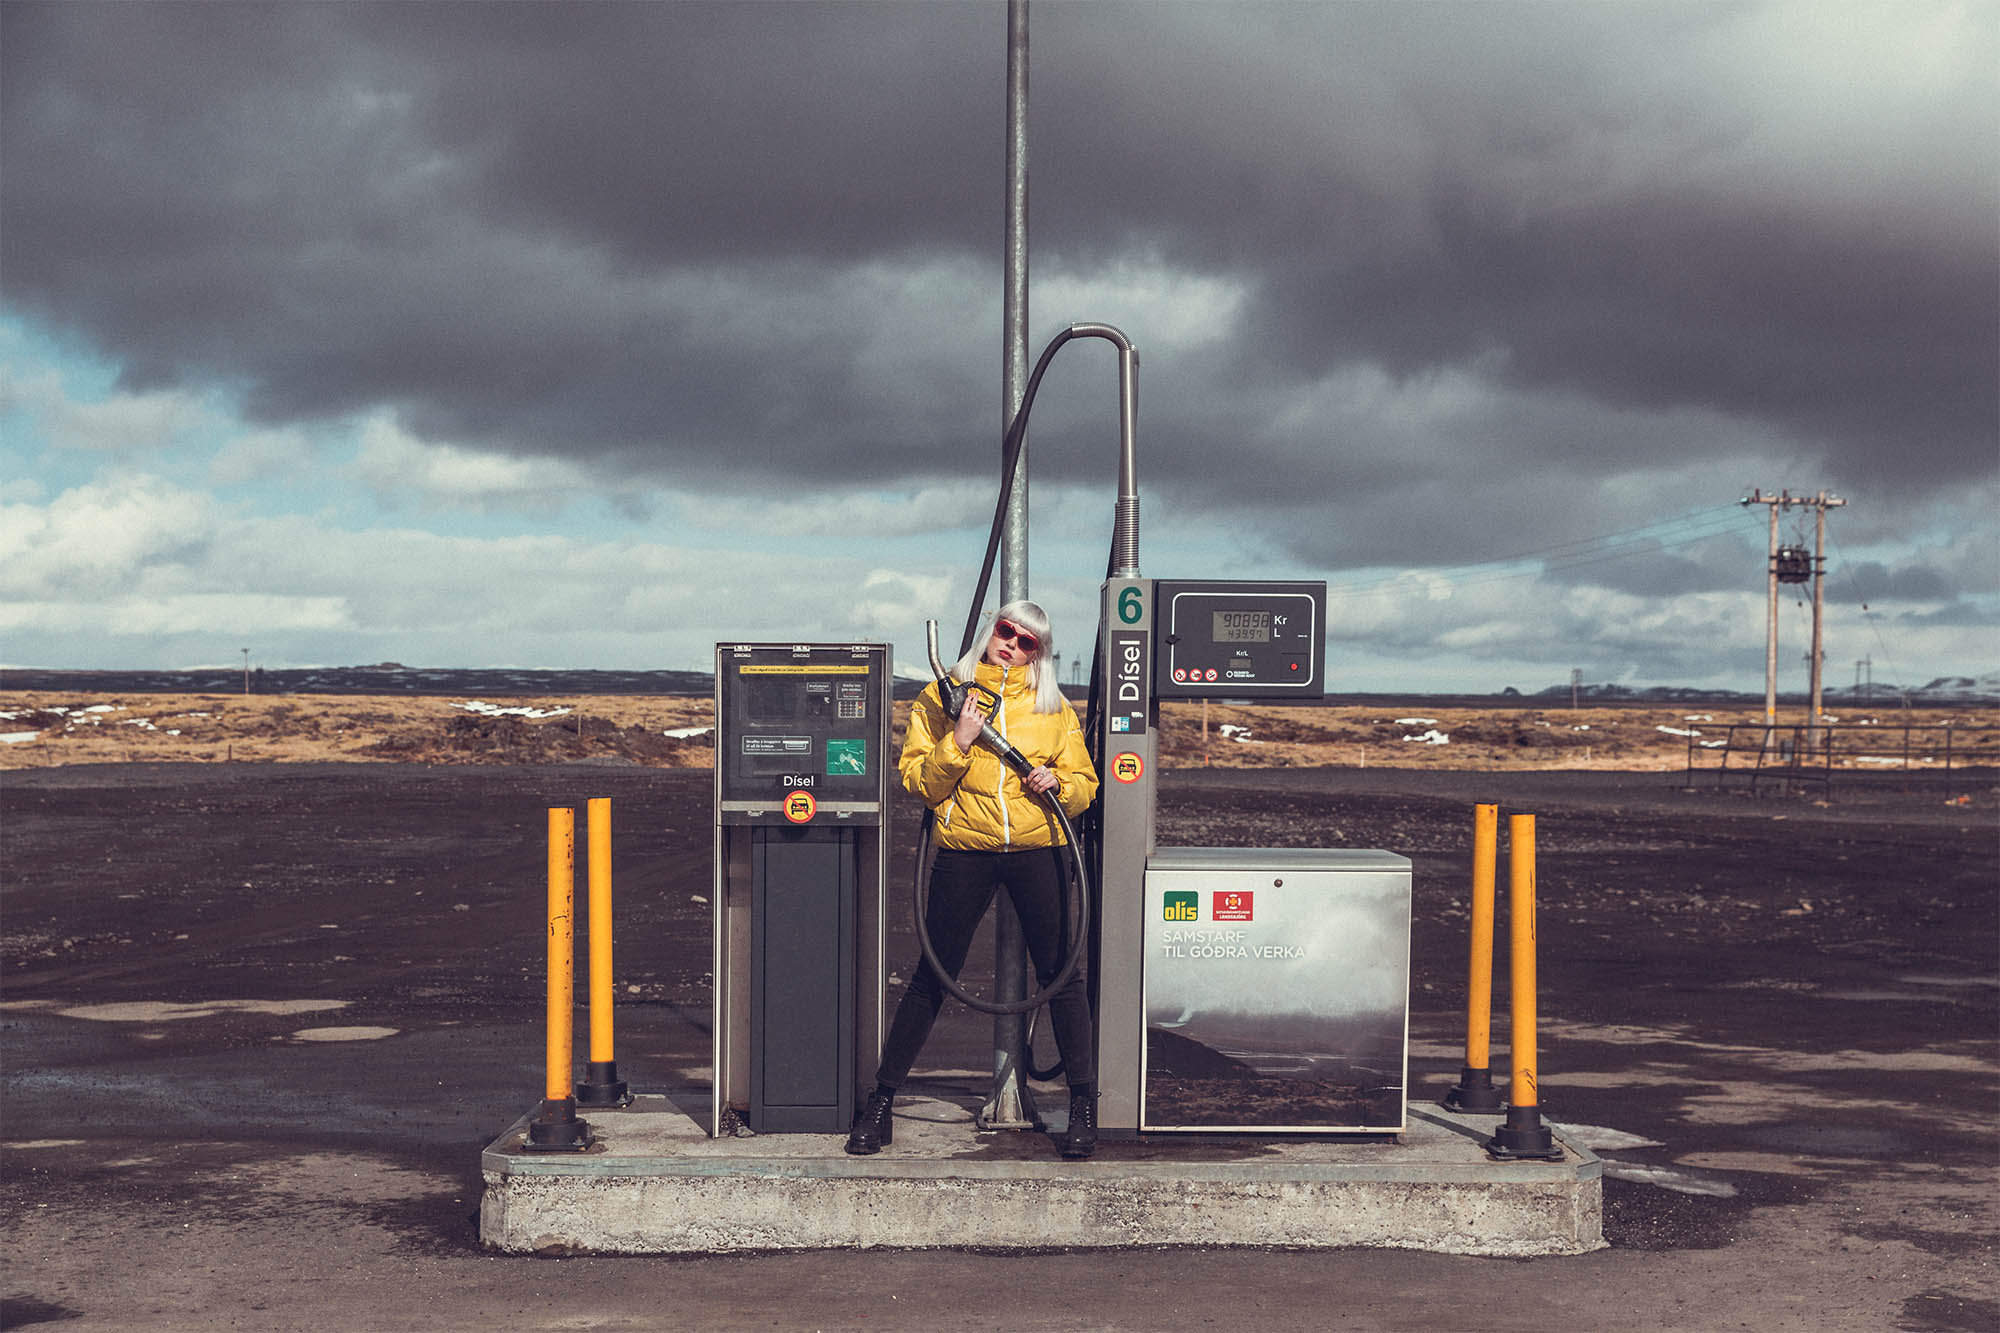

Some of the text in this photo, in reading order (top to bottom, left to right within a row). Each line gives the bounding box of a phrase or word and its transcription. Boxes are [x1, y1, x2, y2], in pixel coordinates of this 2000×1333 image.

[1118, 586, 1143, 625] 6
[1223, 613, 1269, 628] 90898
[1274, 615, 1288, 625] Kr
[1274, 628, 1281, 638] L
[1118, 640, 1141, 701] Dísel
[783, 775, 814, 787] Dísel
[1164, 901, 1197, 921] olís
[1162, 930, 1247, 943] SAMSTARF
[1163, 943, 1306, 958] TIL GÓÐRA VERKA
